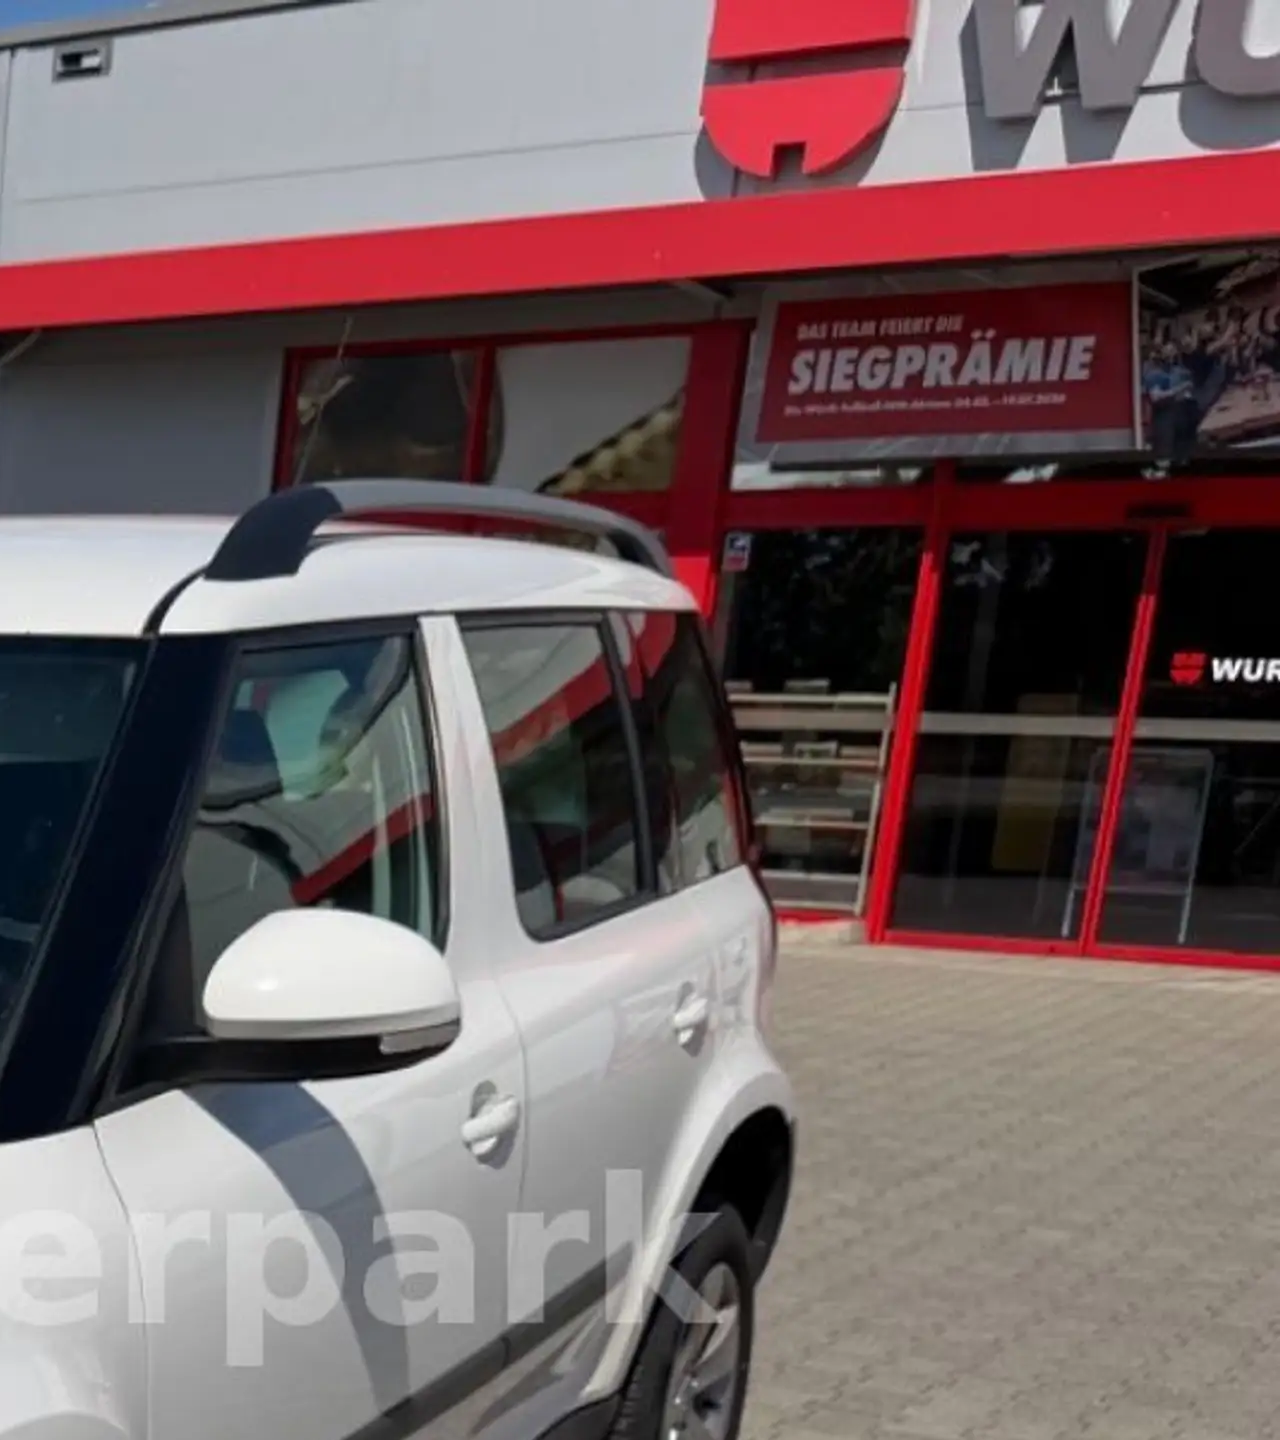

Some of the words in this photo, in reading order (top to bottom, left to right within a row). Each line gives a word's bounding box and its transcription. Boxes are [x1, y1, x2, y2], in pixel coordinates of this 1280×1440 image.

[832, 320, 877, 338] TEAM
[879, 316, 935, 336] FEIERT
[787, 328, 1096, 396] SIEGPRÄMIE
